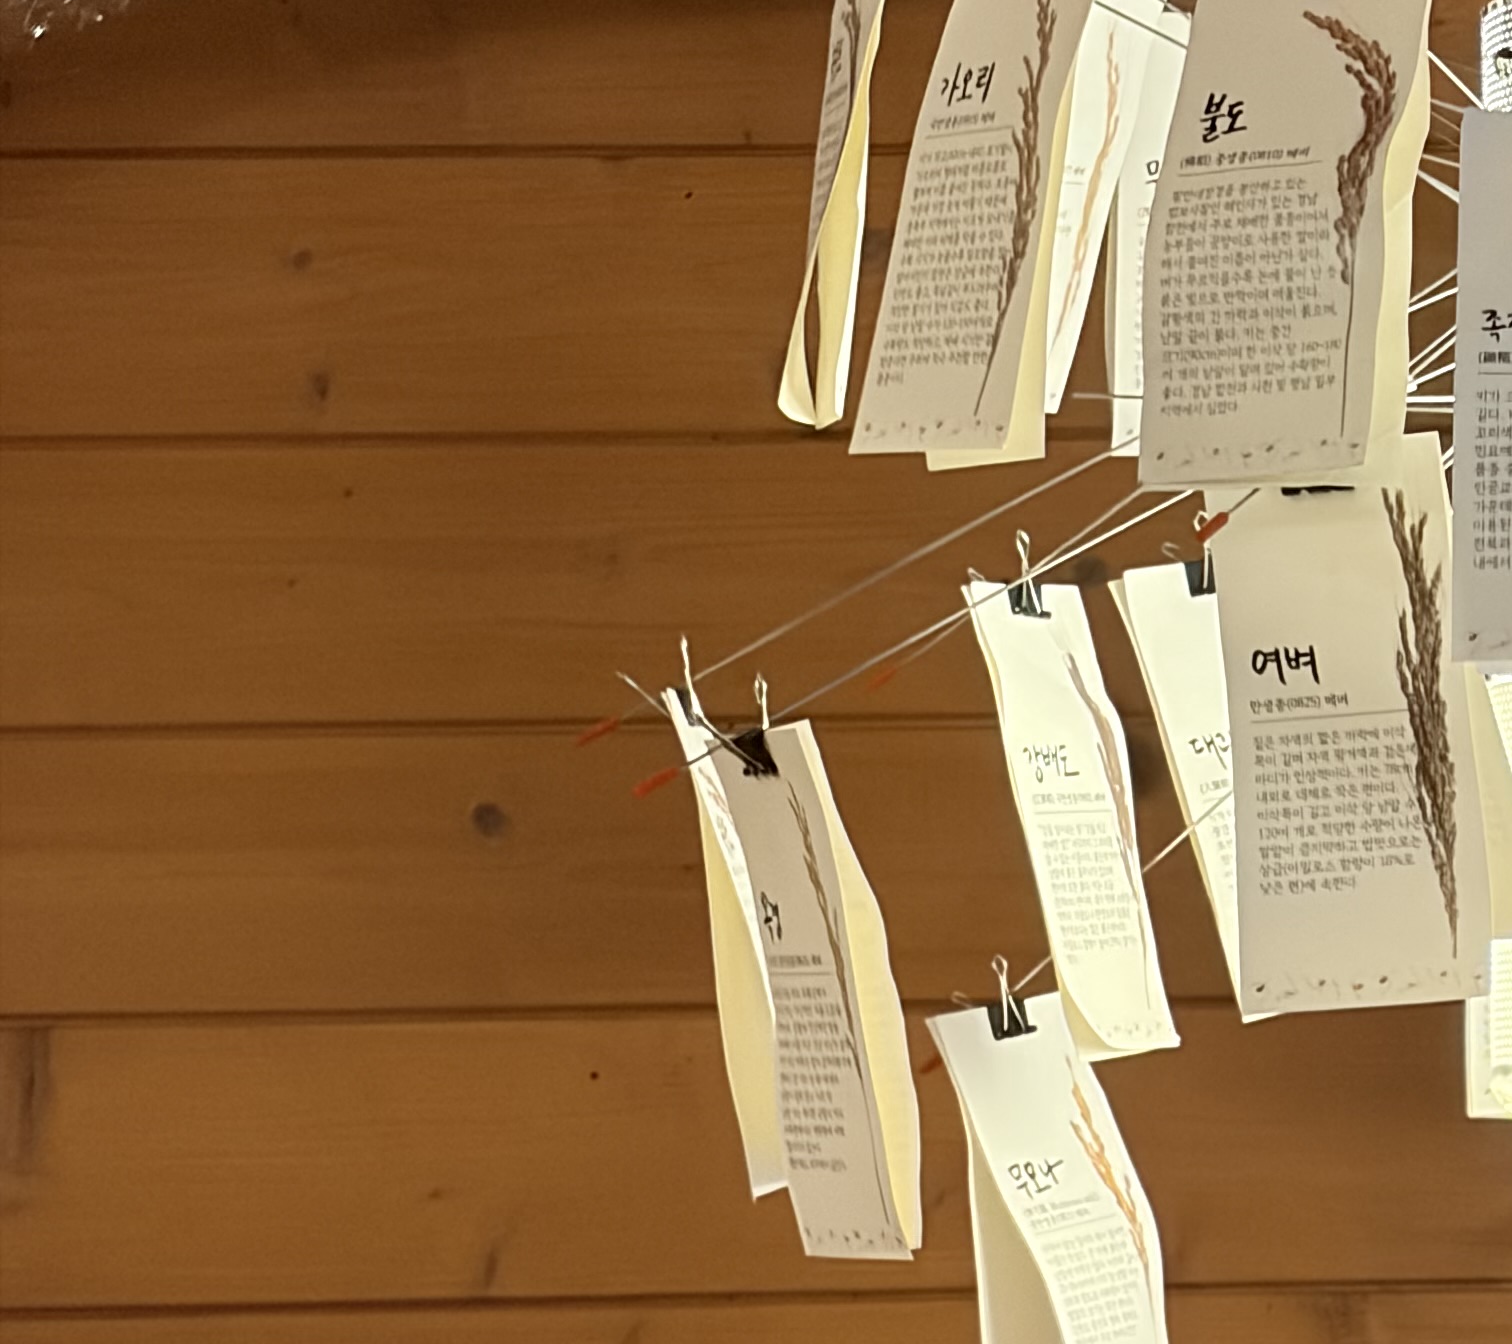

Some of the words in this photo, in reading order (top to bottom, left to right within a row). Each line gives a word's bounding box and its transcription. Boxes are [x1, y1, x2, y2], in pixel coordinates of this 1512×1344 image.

[940, 62, 997, 108] 가오리
[1199, 93, 1248, 143] 불도
[1251, 642, 1321, 685] 여벼
[1022, 744, 1081, 784] 강배도
[1007, 1157, 1065, 1201] 무오나
